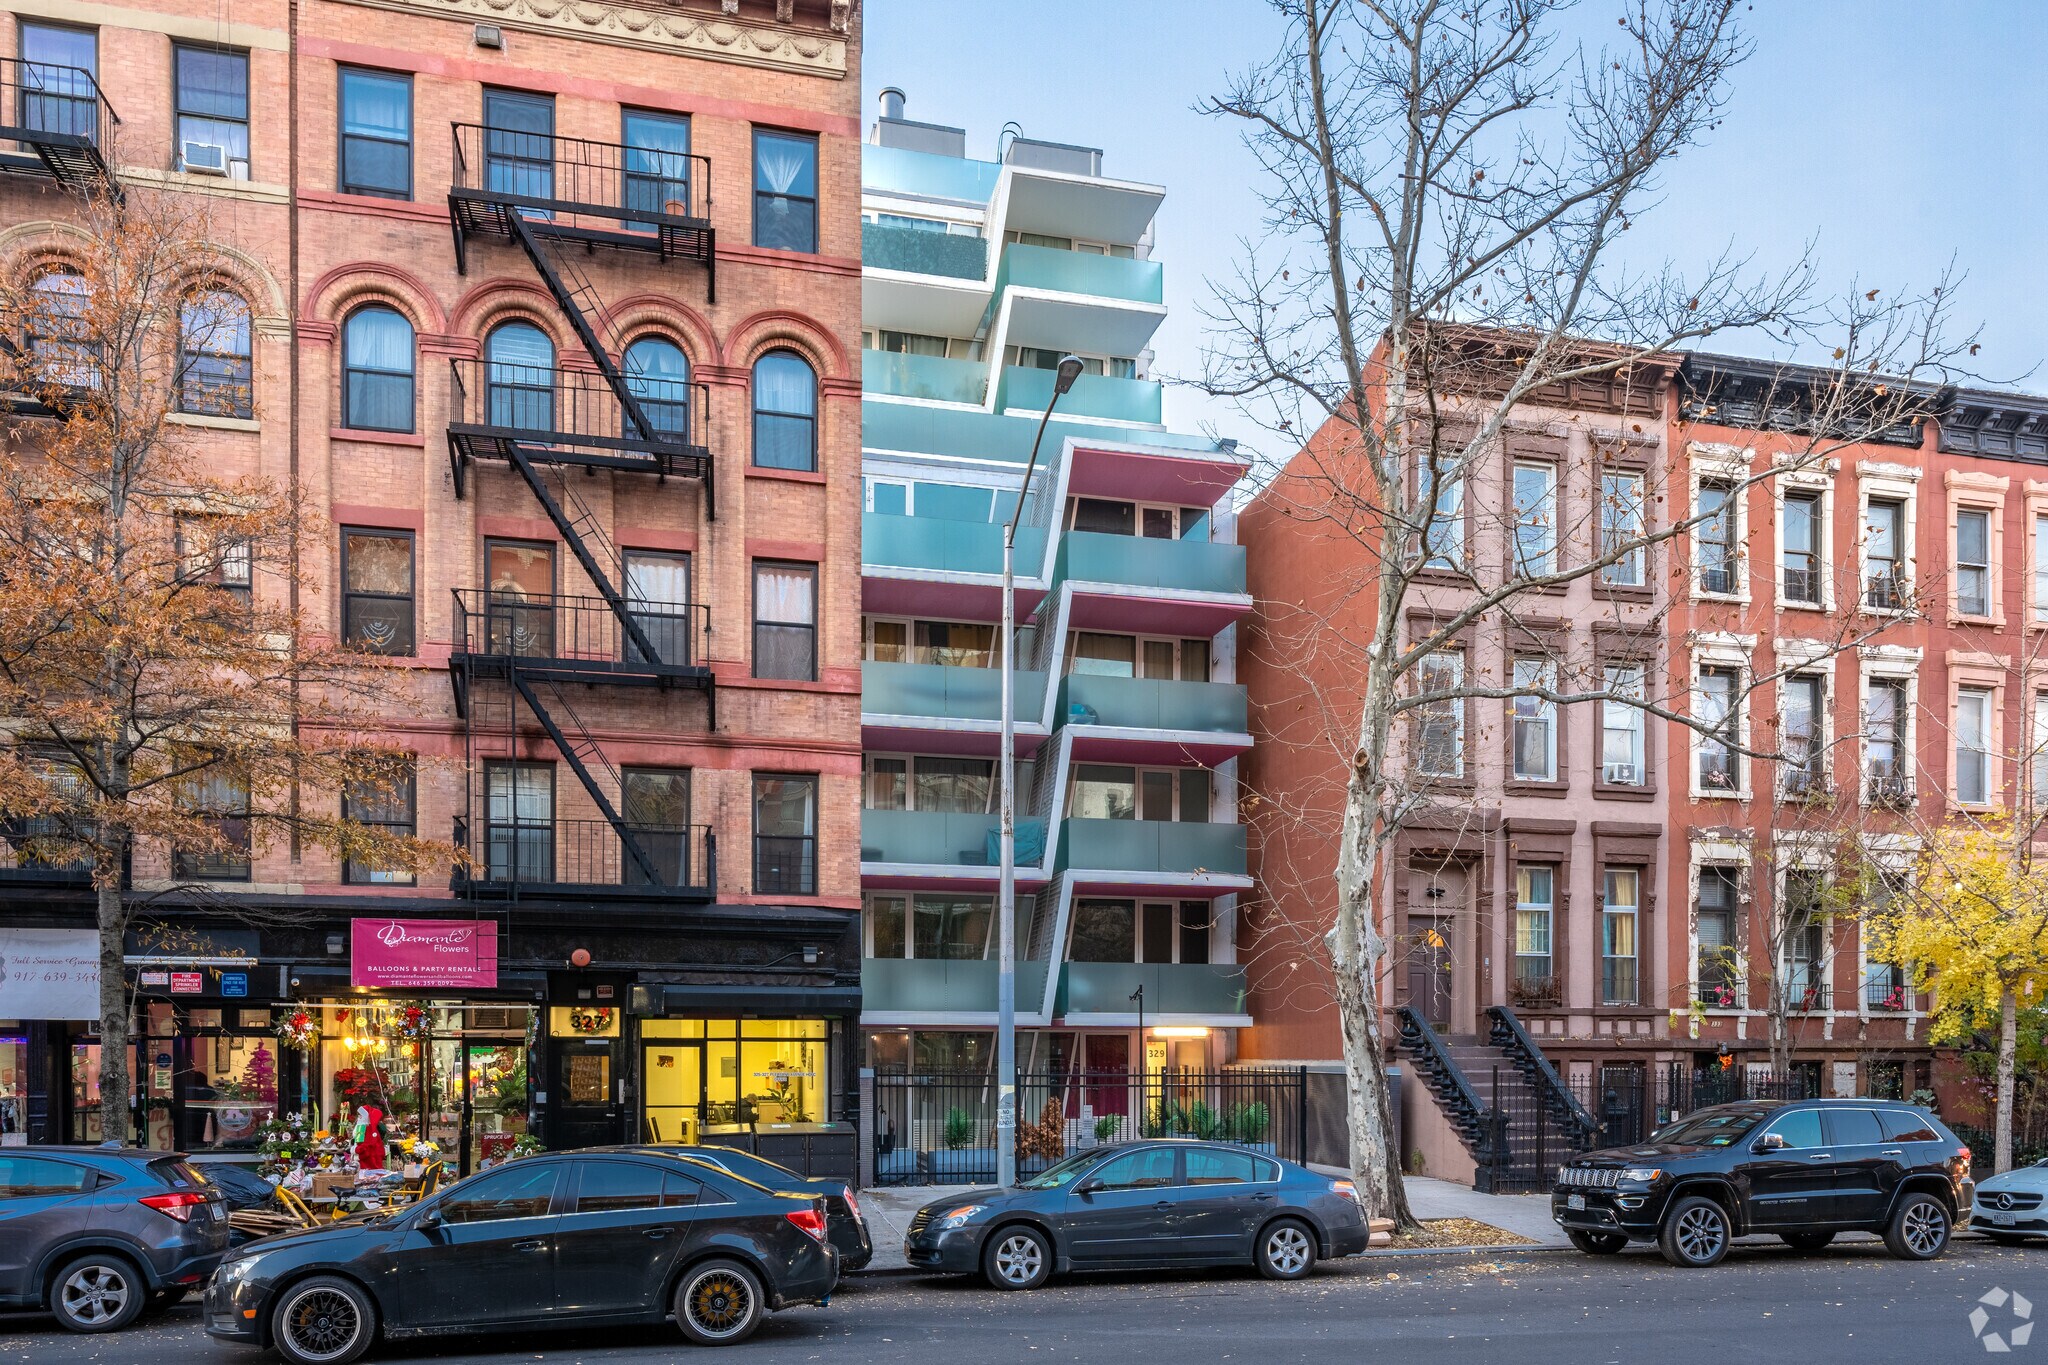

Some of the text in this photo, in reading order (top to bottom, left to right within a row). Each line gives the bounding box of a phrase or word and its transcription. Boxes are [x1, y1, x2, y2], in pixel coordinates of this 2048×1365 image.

[434, 944, 470, 953] Flowers
[33, 956, 63, 965] Service
[571, 1015, 605, 1028] 327
[1148, 1049, 1165, 1058] 329
